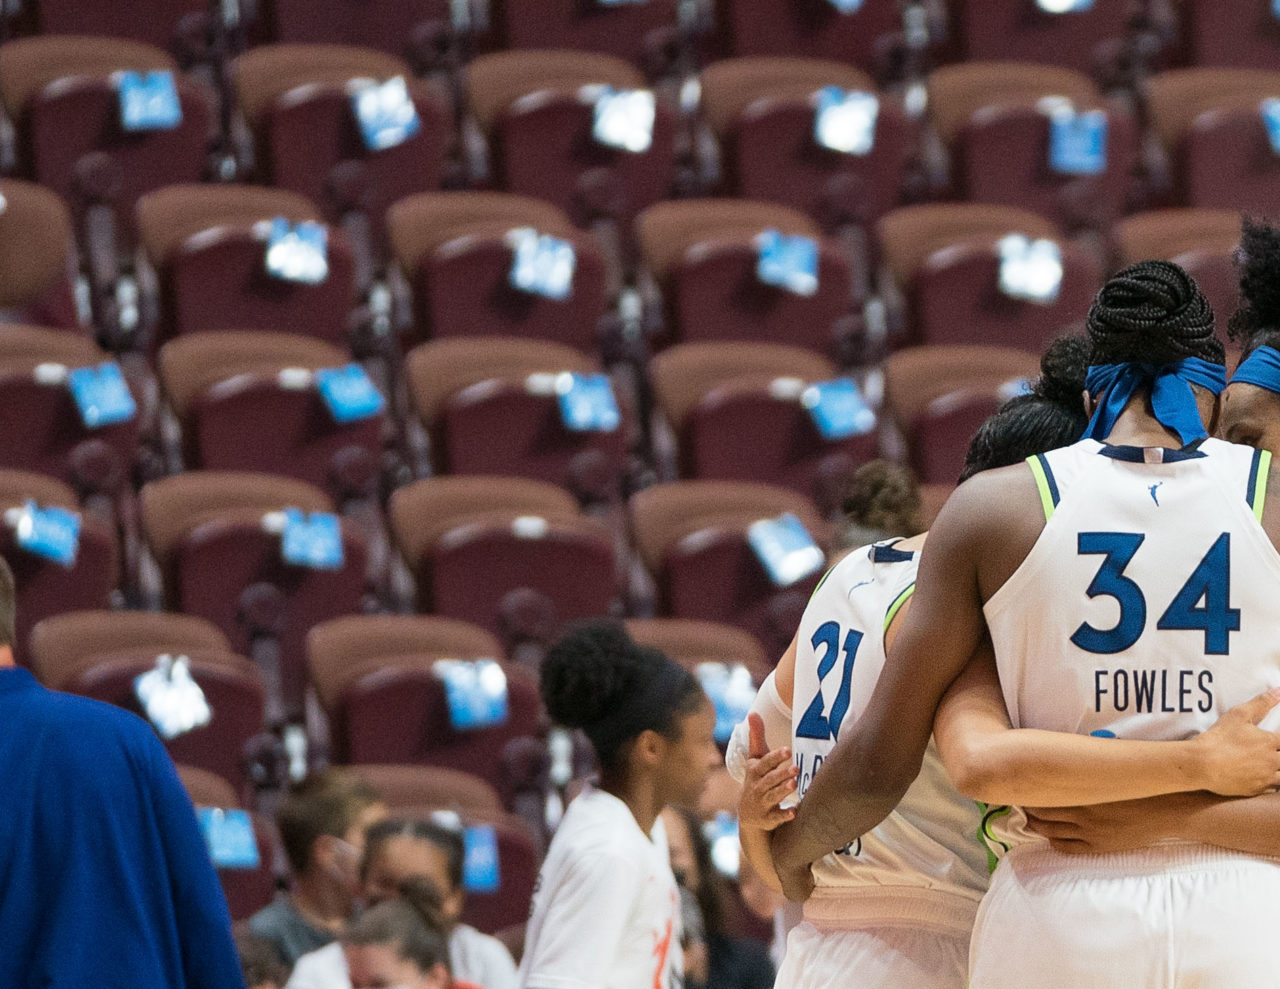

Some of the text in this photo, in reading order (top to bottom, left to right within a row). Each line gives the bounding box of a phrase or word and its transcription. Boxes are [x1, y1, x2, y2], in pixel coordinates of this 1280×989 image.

[1069, 531, 1241, 656] 34
[795, 620, 865, 743] 21
[1094, 668, 1214, 713] FOWLES
